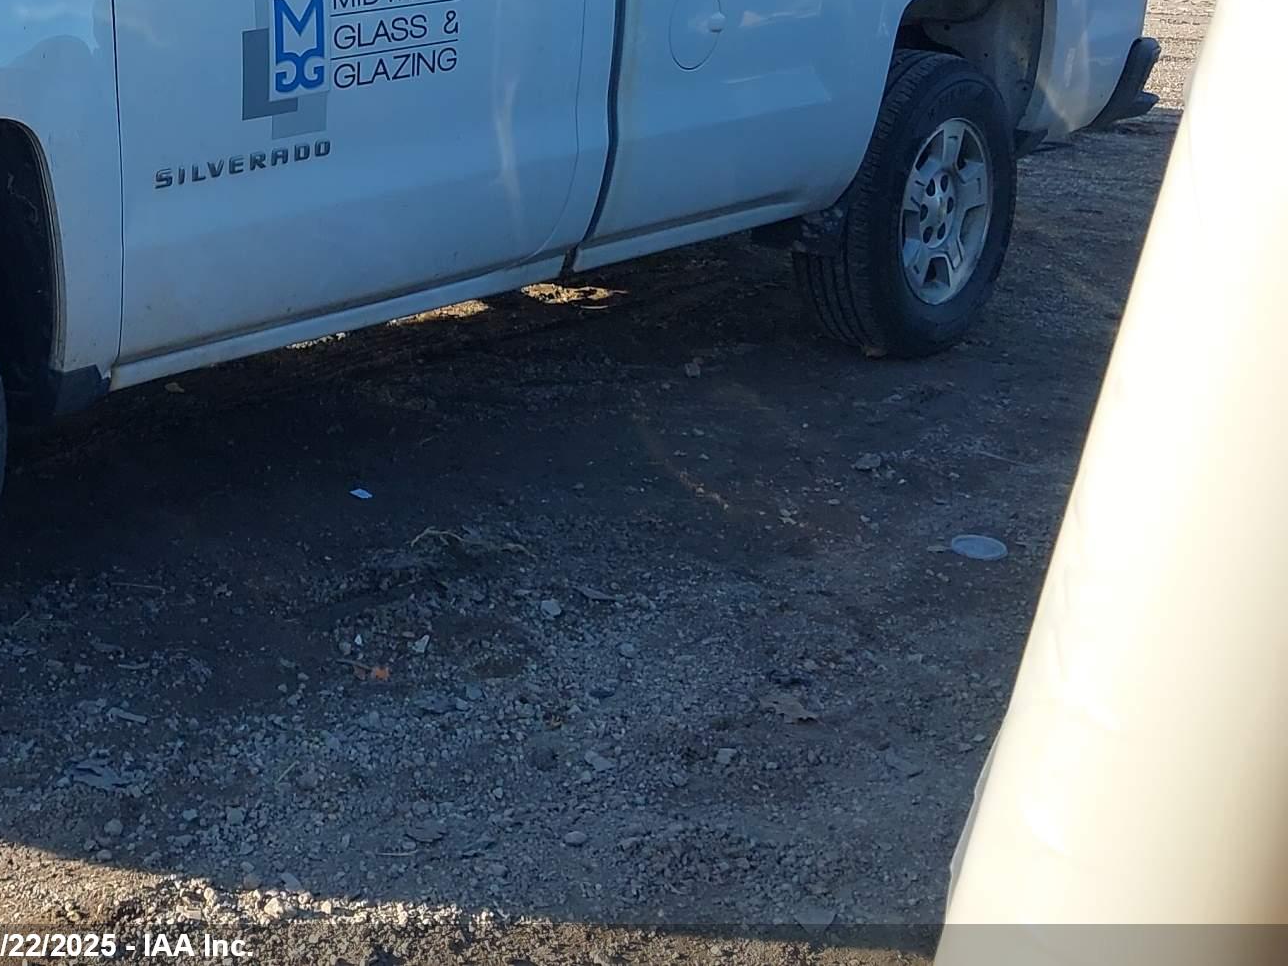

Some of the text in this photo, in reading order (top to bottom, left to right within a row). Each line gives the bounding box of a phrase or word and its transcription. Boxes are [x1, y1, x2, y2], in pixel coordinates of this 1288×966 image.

[333, 10, 459, 50] GLASS &
[333, 47, 458, 89] GLAZING
[155, 140, 331, 188] SILVERADO
